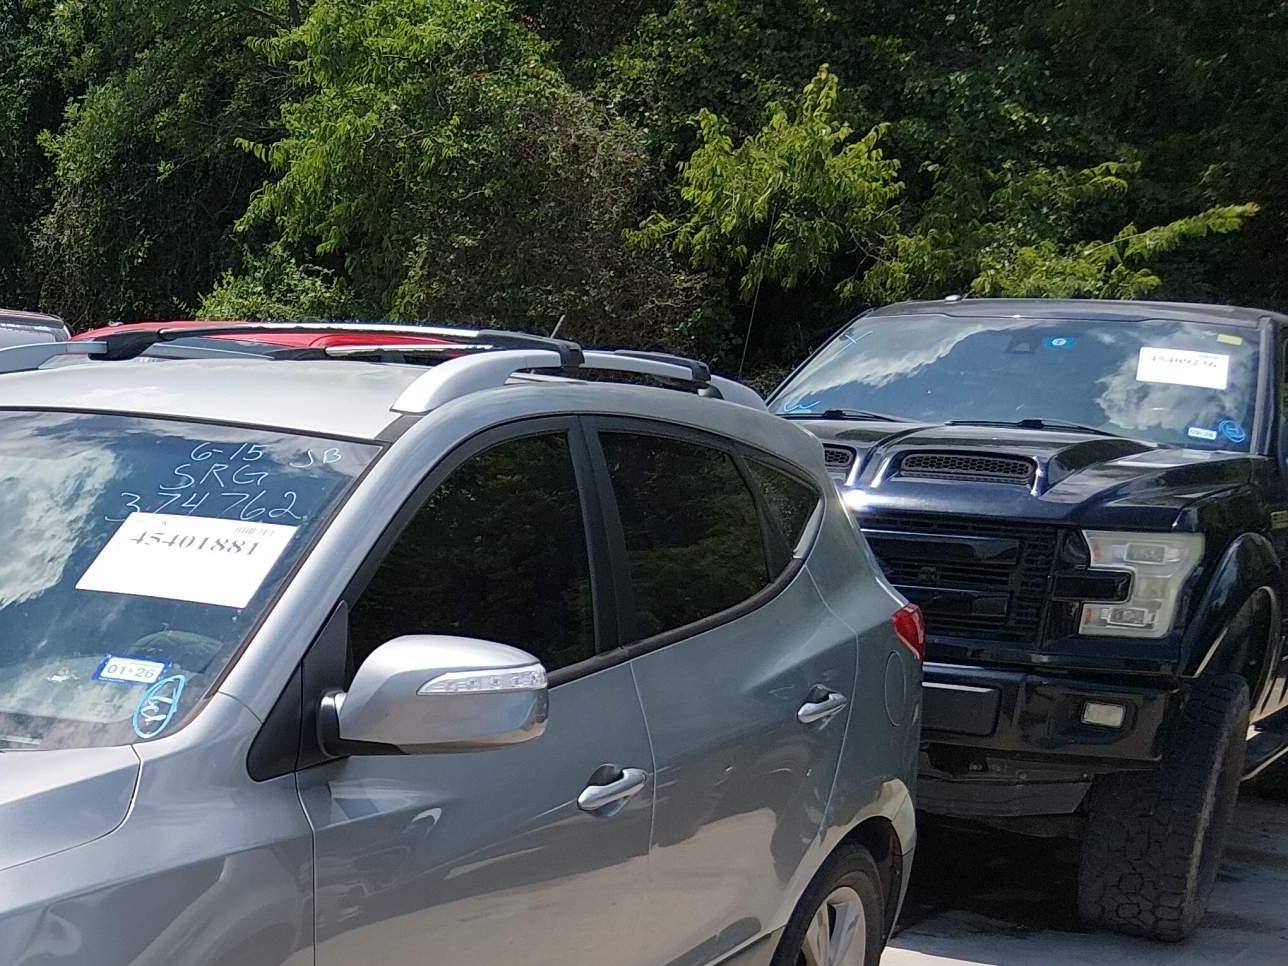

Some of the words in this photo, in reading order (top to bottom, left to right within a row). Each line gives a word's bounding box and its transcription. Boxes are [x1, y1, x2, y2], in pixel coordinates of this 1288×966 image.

[190, 442, 264, 461] 6-15
[159, 463, 269, 490] SRG
[128, 531, 260, 556] 45401881
